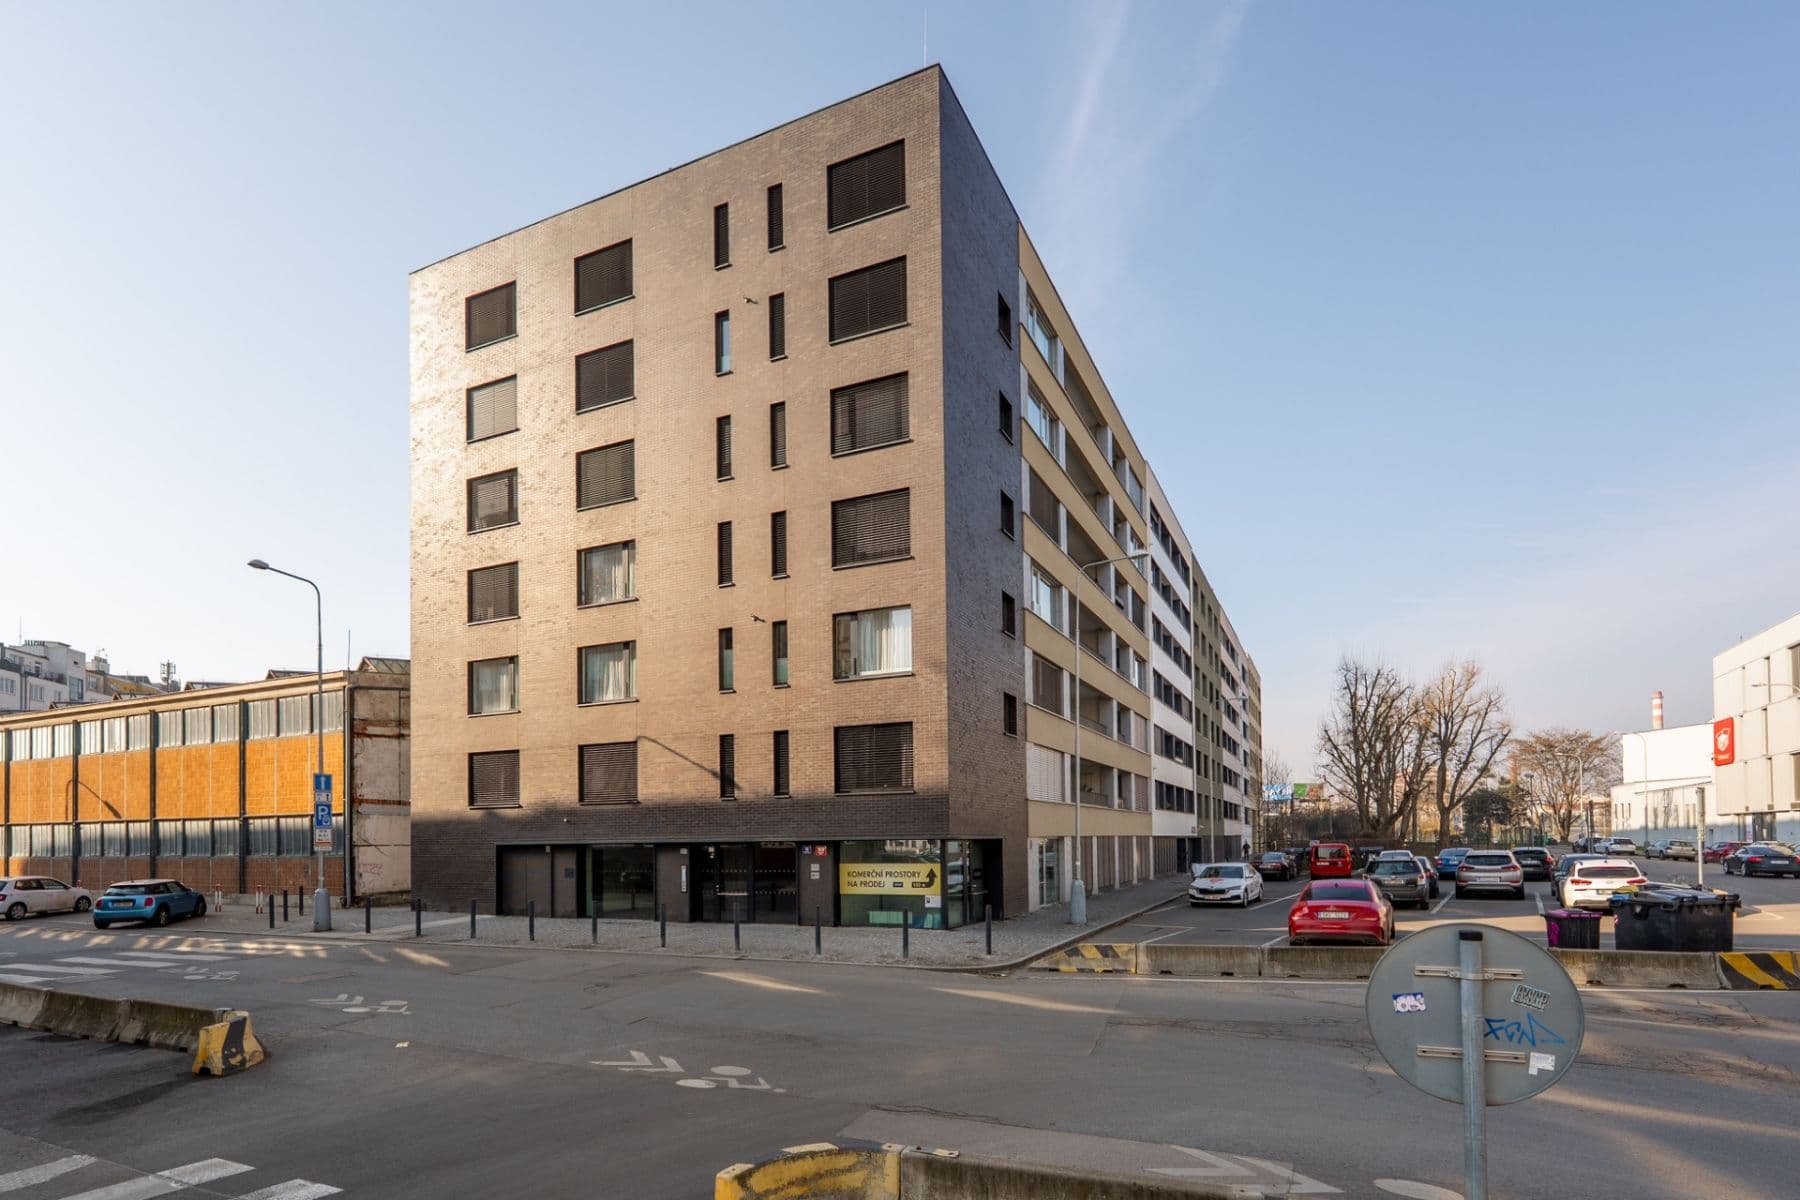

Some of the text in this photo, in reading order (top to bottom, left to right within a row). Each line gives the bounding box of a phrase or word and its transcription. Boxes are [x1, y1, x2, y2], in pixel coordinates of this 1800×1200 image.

[318, 806, 329, 820] P
[847, 869, 920, 878] KOMERČNÍ PROSTORY
